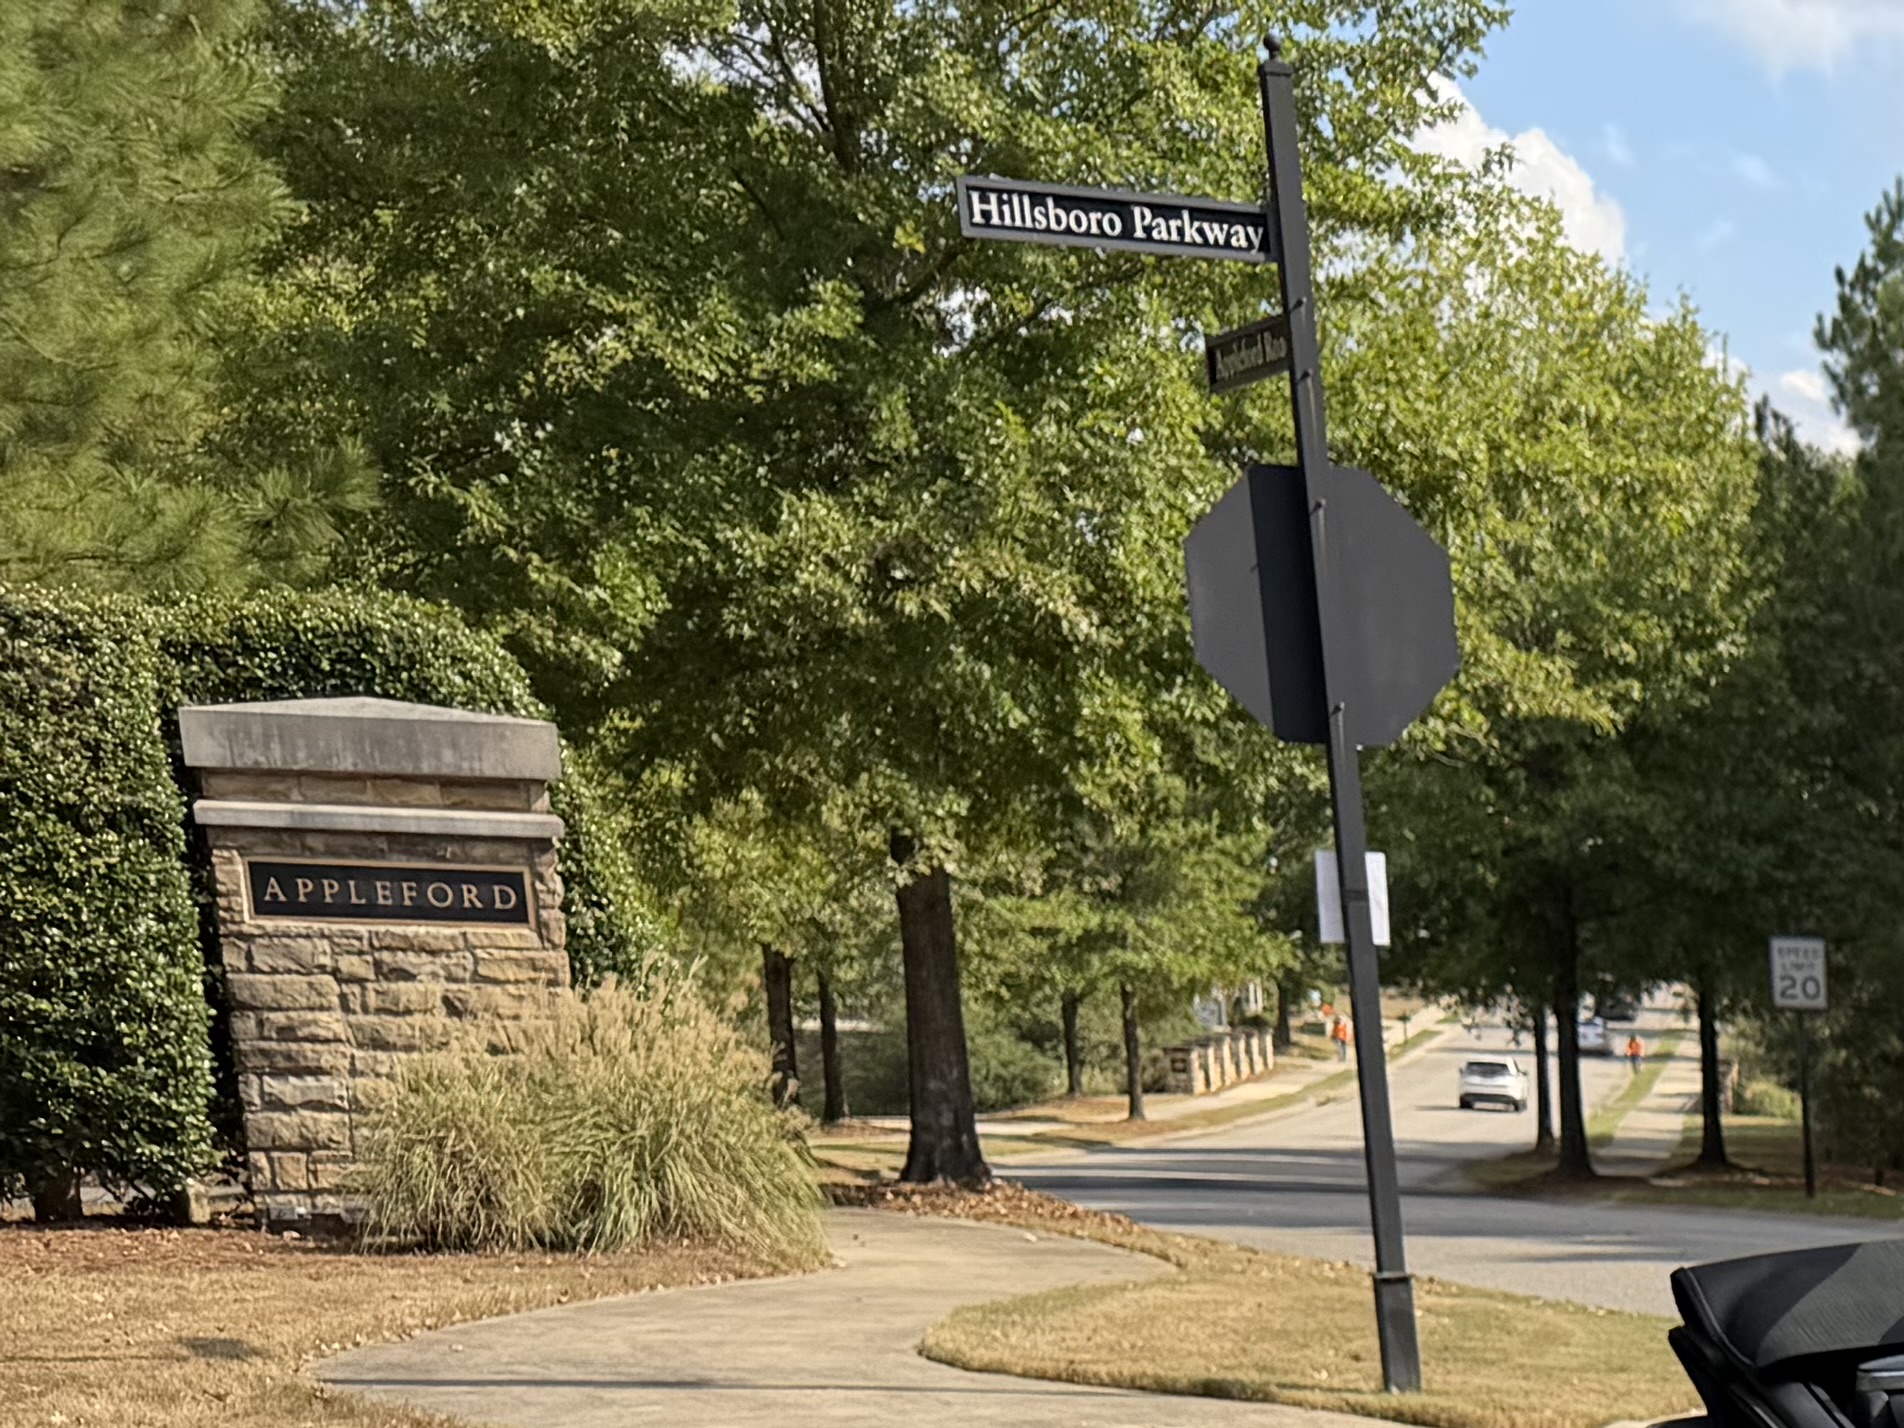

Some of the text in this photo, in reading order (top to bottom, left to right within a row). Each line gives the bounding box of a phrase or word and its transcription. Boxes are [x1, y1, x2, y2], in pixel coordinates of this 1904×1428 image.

[969, 190, 1264, 253] Hillsboro Parkway
[264, 876, 517, 910] APPLEFORD
[1779, 974, 1821, 1001] 20
